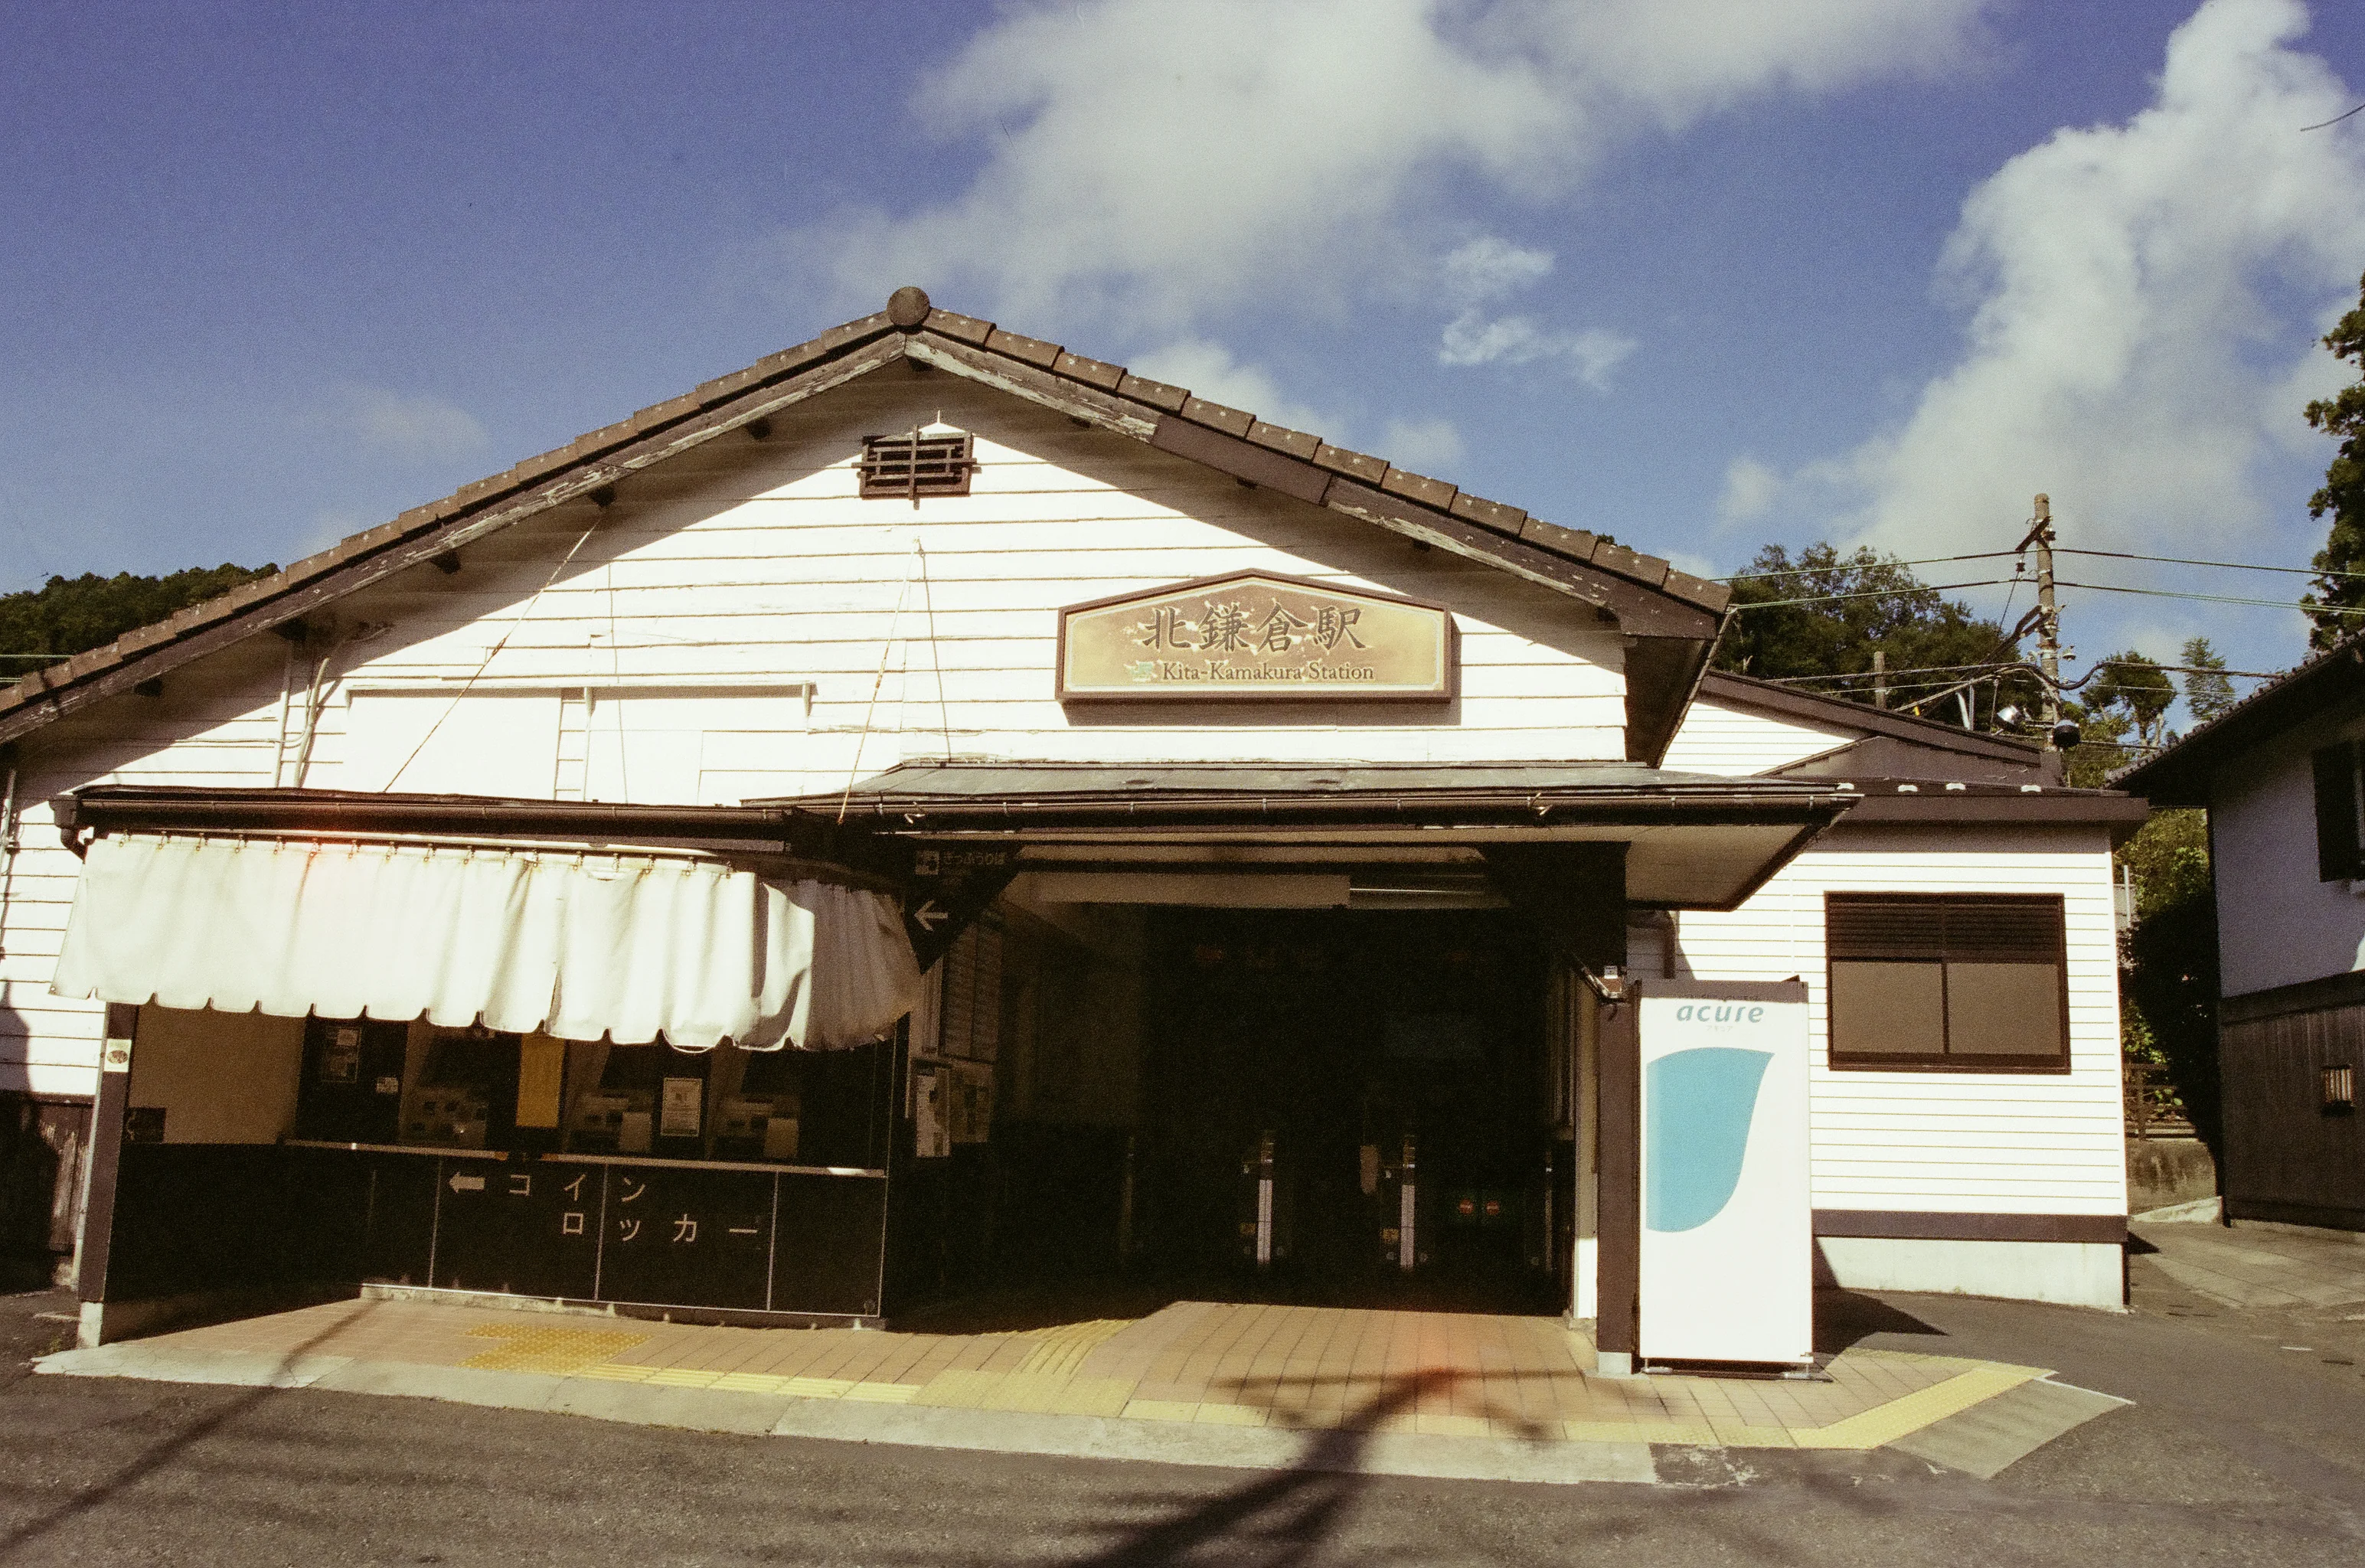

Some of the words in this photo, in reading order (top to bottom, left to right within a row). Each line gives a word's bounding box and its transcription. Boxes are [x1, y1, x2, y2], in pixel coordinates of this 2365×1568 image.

[1142, 603, 1367, 653] 北鎌倉駅
[1162, 662, 1302, 681] Kita-Kamakura
[1308, 662, 1374, 680] Station
[1677, 1004, 1764, 1024] acure
[509, 1173, 646, 1202] コイン
[563, 1212, 758, 1243] ロッカー
